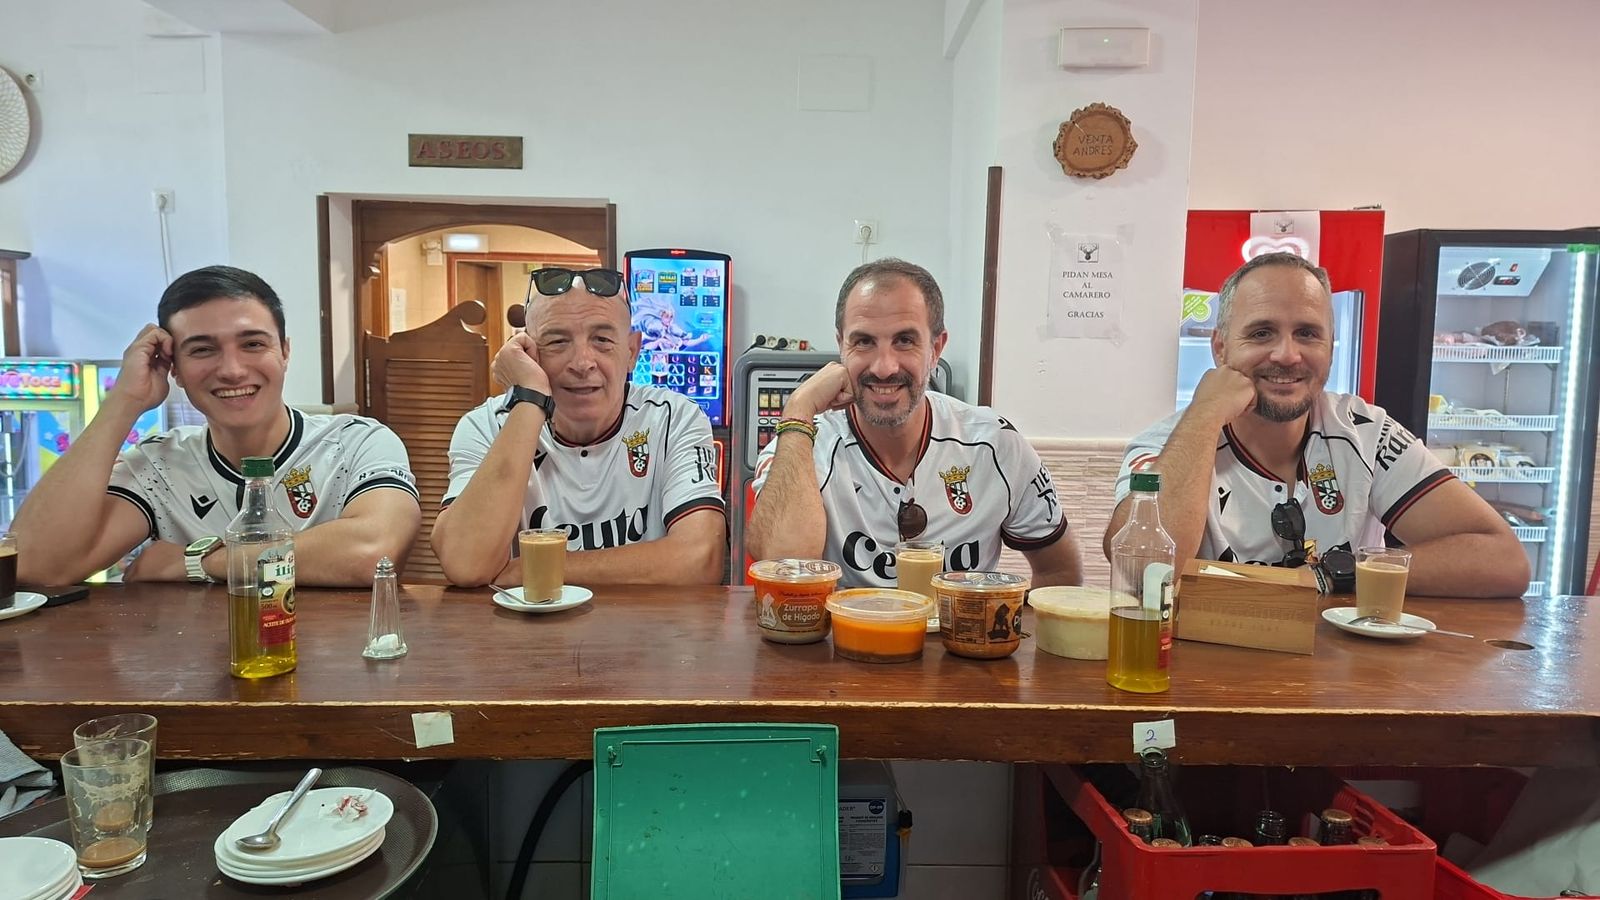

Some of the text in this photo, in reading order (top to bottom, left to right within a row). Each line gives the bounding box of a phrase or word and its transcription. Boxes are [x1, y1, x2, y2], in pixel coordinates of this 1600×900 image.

[1078, 134, 1114, 145] VENTA
[416, 140, 506, 161] ASEOS
[1072, 145, 1114, 157] ANDRES
[1062, 271, 1114, 279] PIDAN MESA
[1081, 281, 1093, 289] AL
[1062, 291, 1112, 299] CAMARERO
[1067, 311, 1104, 319] GRACIAS
[843, 531, 979, 580] Cea
[783, 603, 819, 615] Zurrapa
[782, 612, 793, 621] de
[1145, 729, 1158, 742] 2
